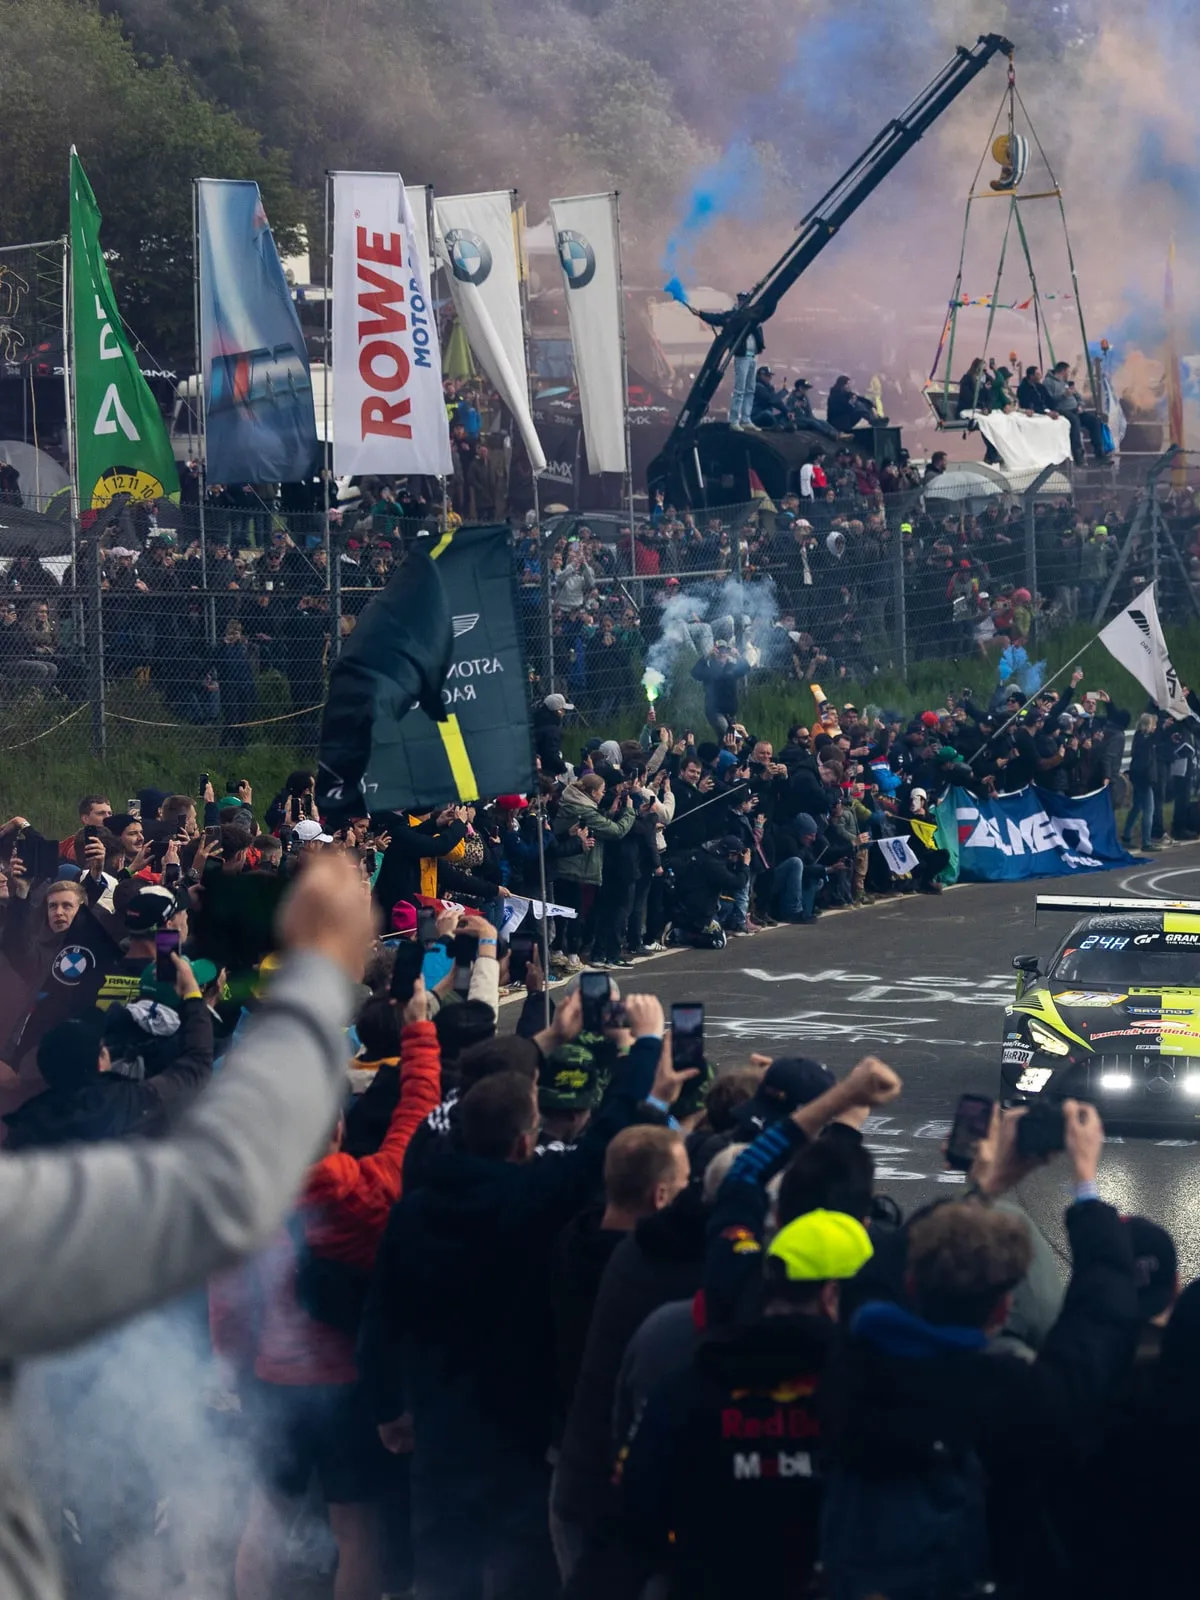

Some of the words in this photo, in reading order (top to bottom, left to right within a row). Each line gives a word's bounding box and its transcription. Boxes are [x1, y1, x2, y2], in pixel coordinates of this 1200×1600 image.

[357, 226, 412, 442] ROWE
[1080, 935, 1130, 950] 24H
[1165, 934, 1199, 943] GRAN
[107, 977, 139, 986] RAVE
[1132, 1007, 1191, 1016] RAVENOL
[721, 1408, 785, 1439] Red
